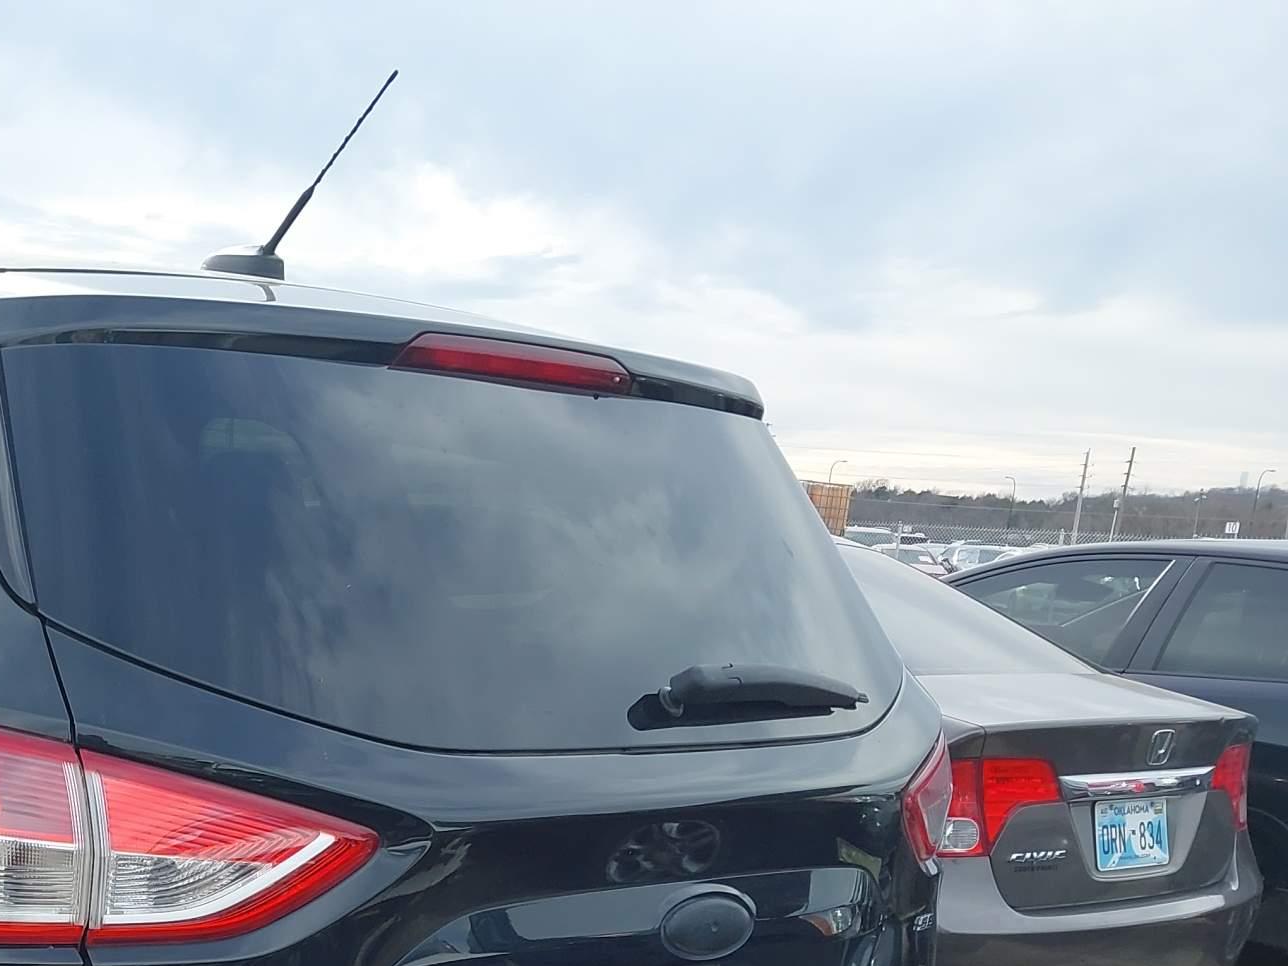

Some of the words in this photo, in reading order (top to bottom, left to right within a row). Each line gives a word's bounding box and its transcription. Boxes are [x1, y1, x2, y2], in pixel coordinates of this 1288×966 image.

[1114, 804, 1149, 816] OKLAHOMA
[1139, 820, 1163, 850] 834
[1009, 850, 1067, 862] CIVIC
